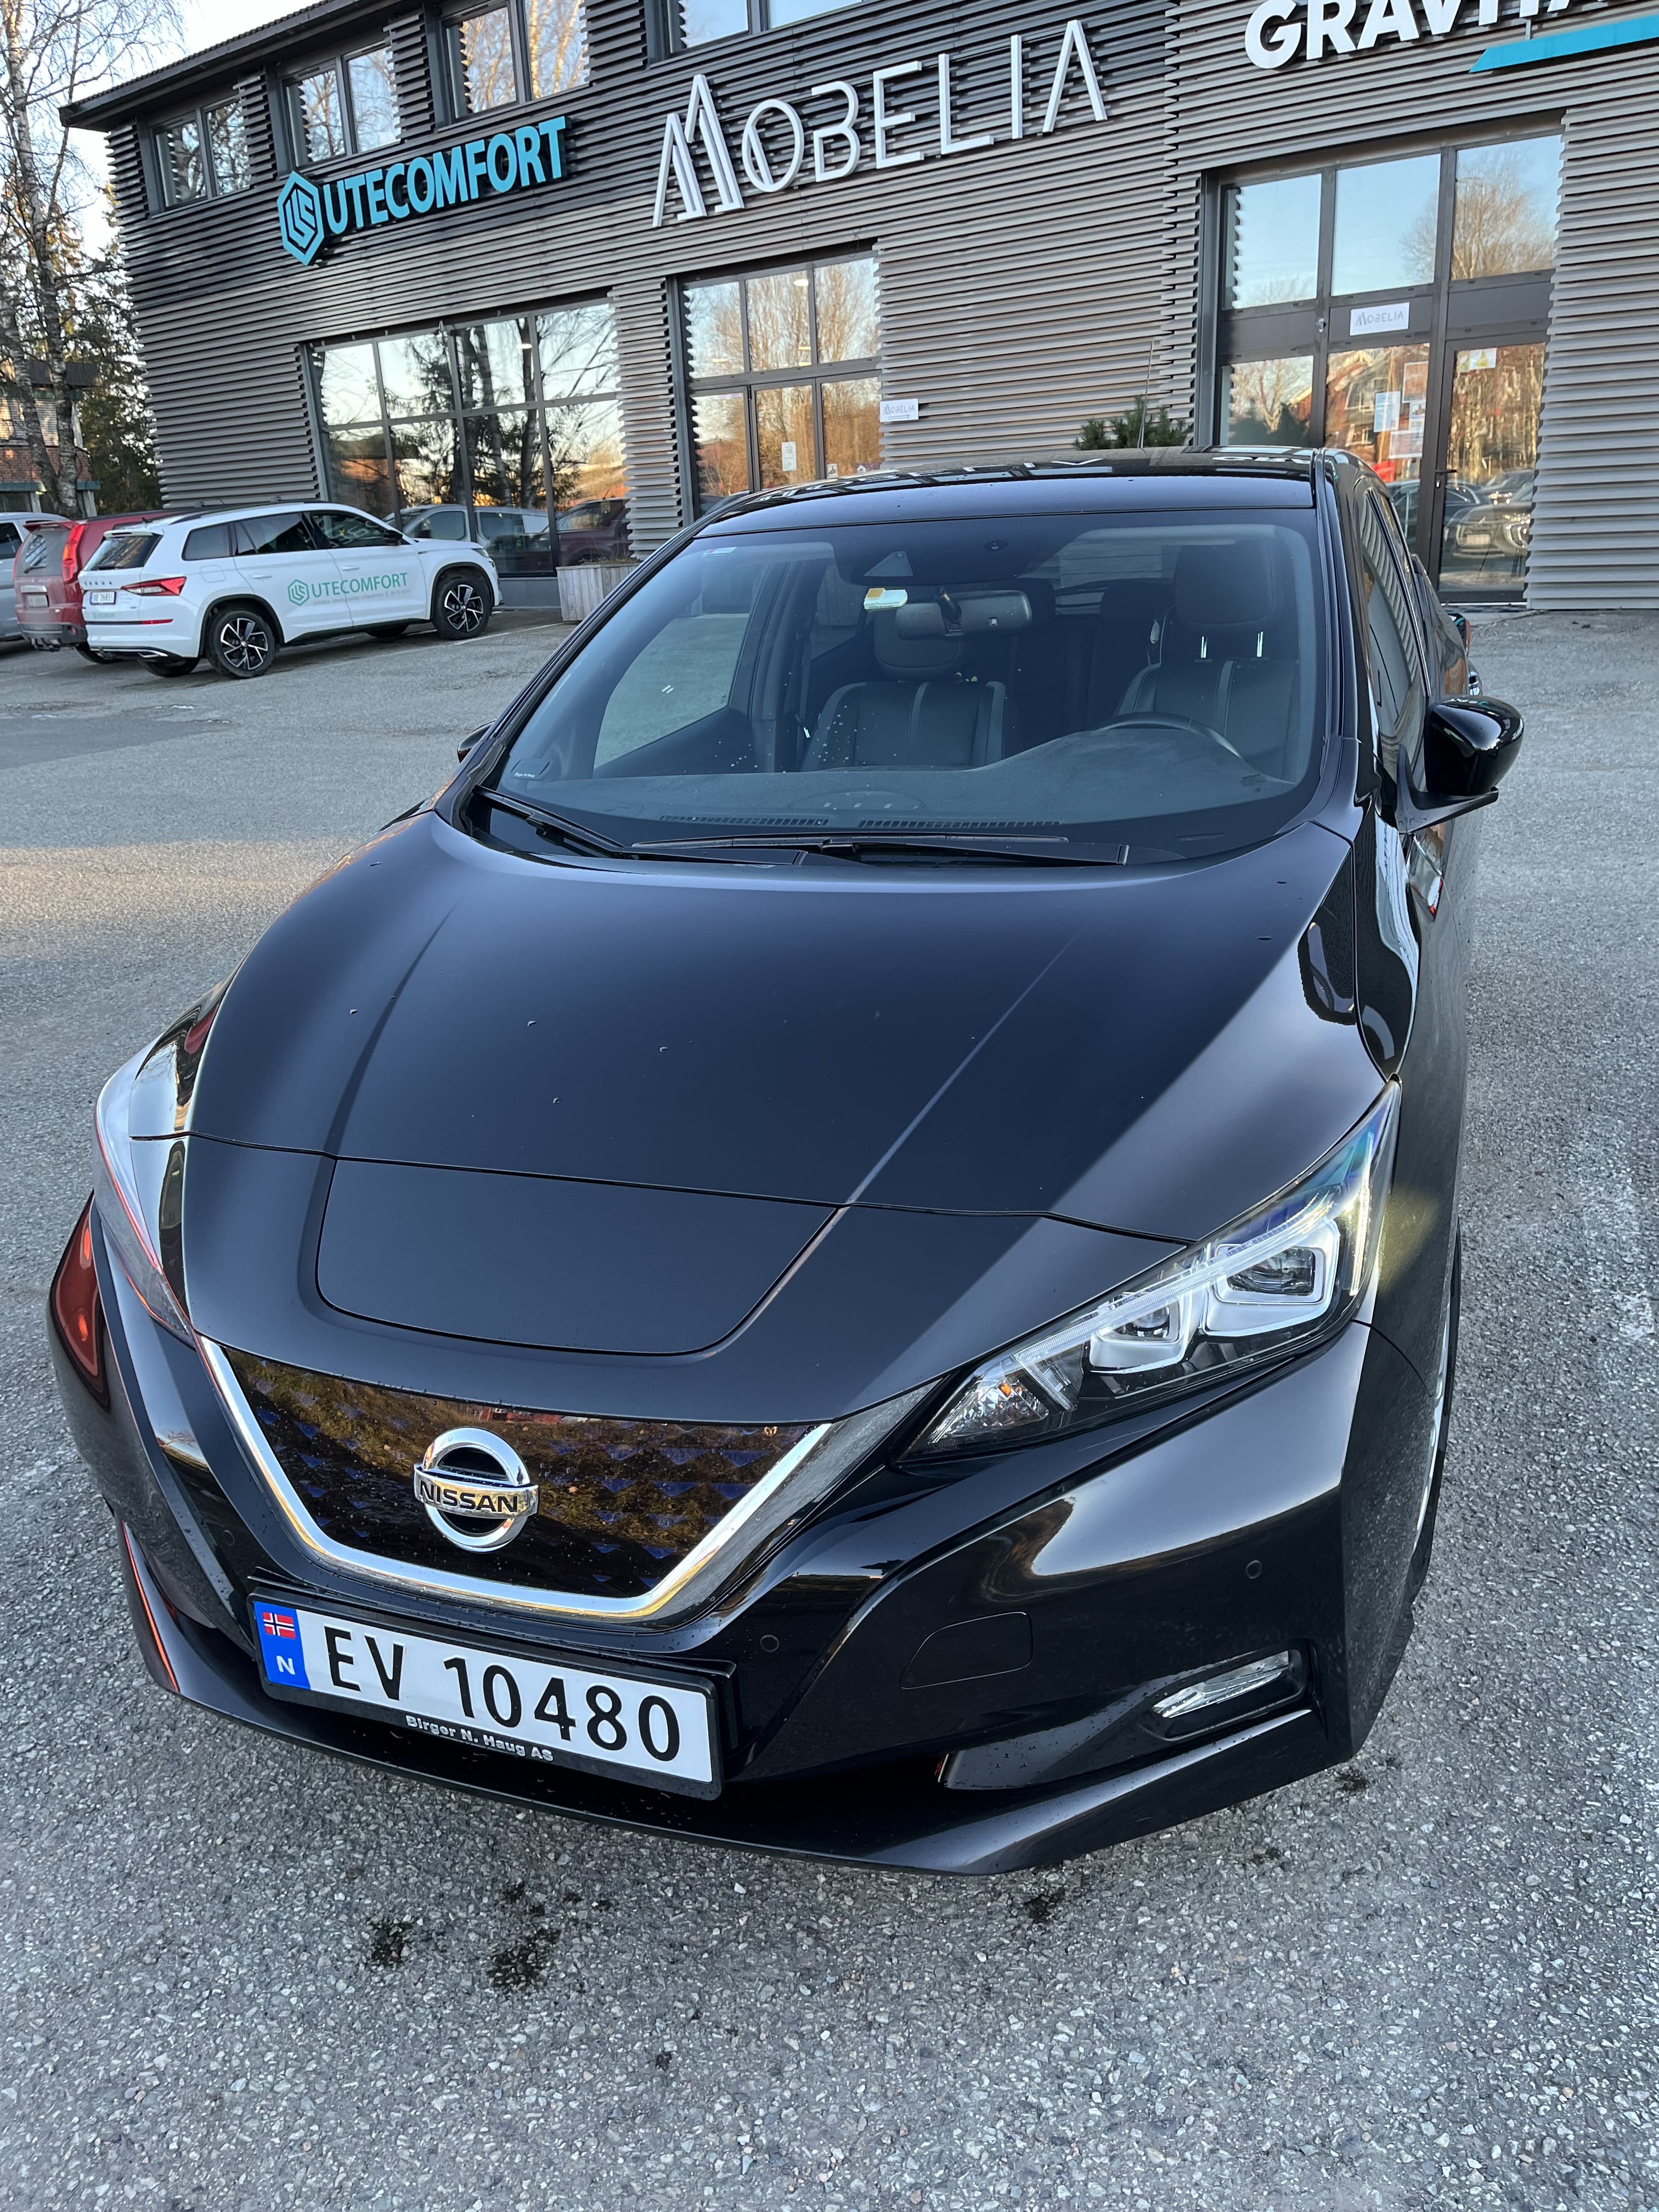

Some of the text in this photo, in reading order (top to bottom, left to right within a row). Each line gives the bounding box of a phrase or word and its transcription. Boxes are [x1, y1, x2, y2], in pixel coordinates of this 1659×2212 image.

[1244, 0, 1609, 69] GRAV
[652, 20, 1108, 227] MOBELIA
[323, 116, 567, 235] UTECOMFORT
[1356, 311, 1404, 326] MOBELIA
[883, 404, 916, 415] MOBELIA
[311, 572, 408, 597] UTECOMFORT
[420, 1480, 518, 1513] NISSAN
[276, 1655, 296, 1675] N
[324, 1625, 681, 1762] EV 10480
[405, 1715, 554, 1762] Birger N. Haug AS
